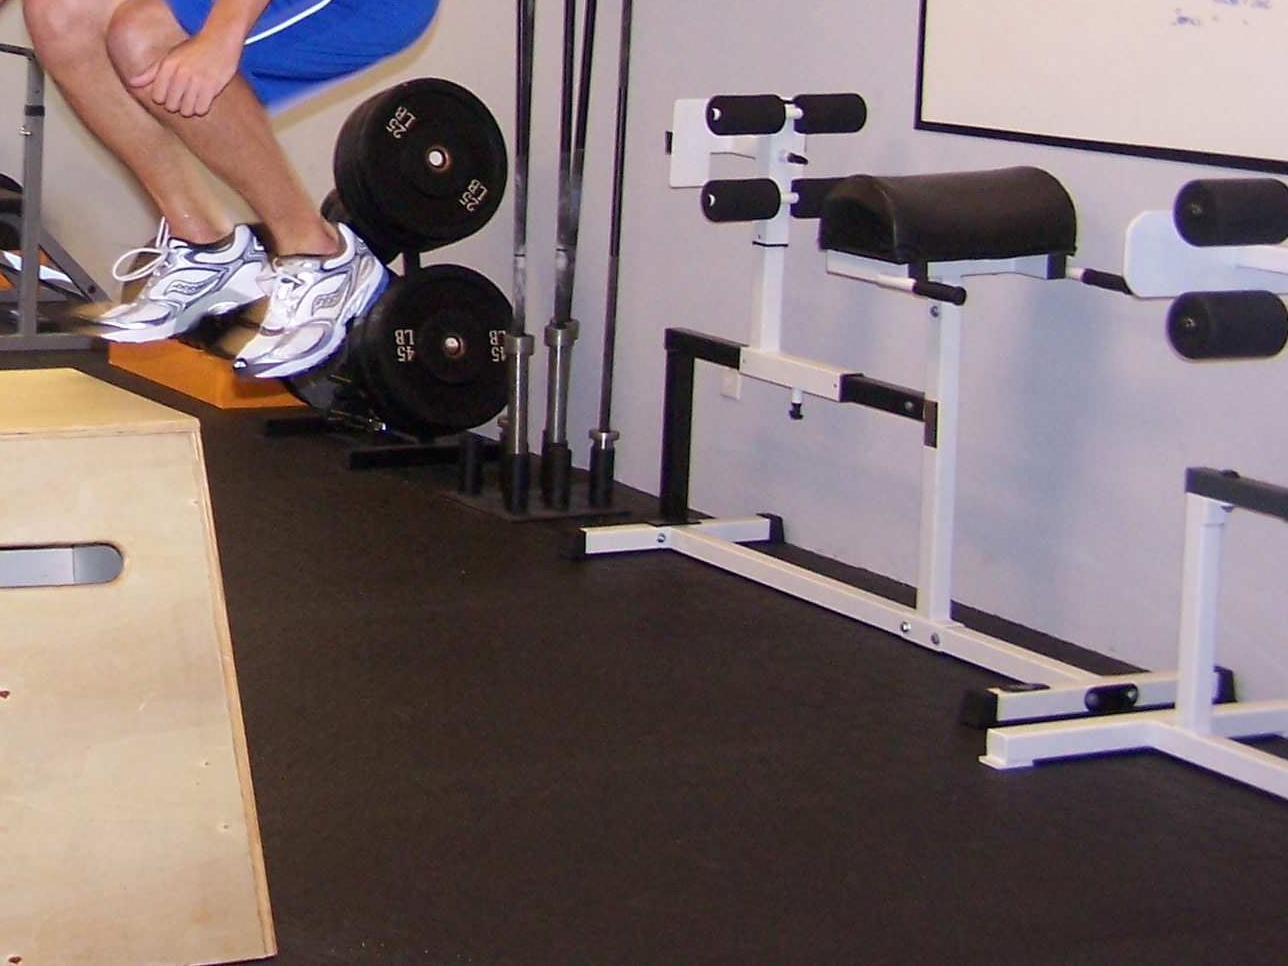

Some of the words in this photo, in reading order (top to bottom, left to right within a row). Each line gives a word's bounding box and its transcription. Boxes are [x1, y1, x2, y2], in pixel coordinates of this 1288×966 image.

[385, 118, 407, 139] 25
[468, 179, 488, 201] LB
[459, 192, 480, 212] 25
[394, 329, 415, 345] LB
[396, 346, 415, 362] 45
